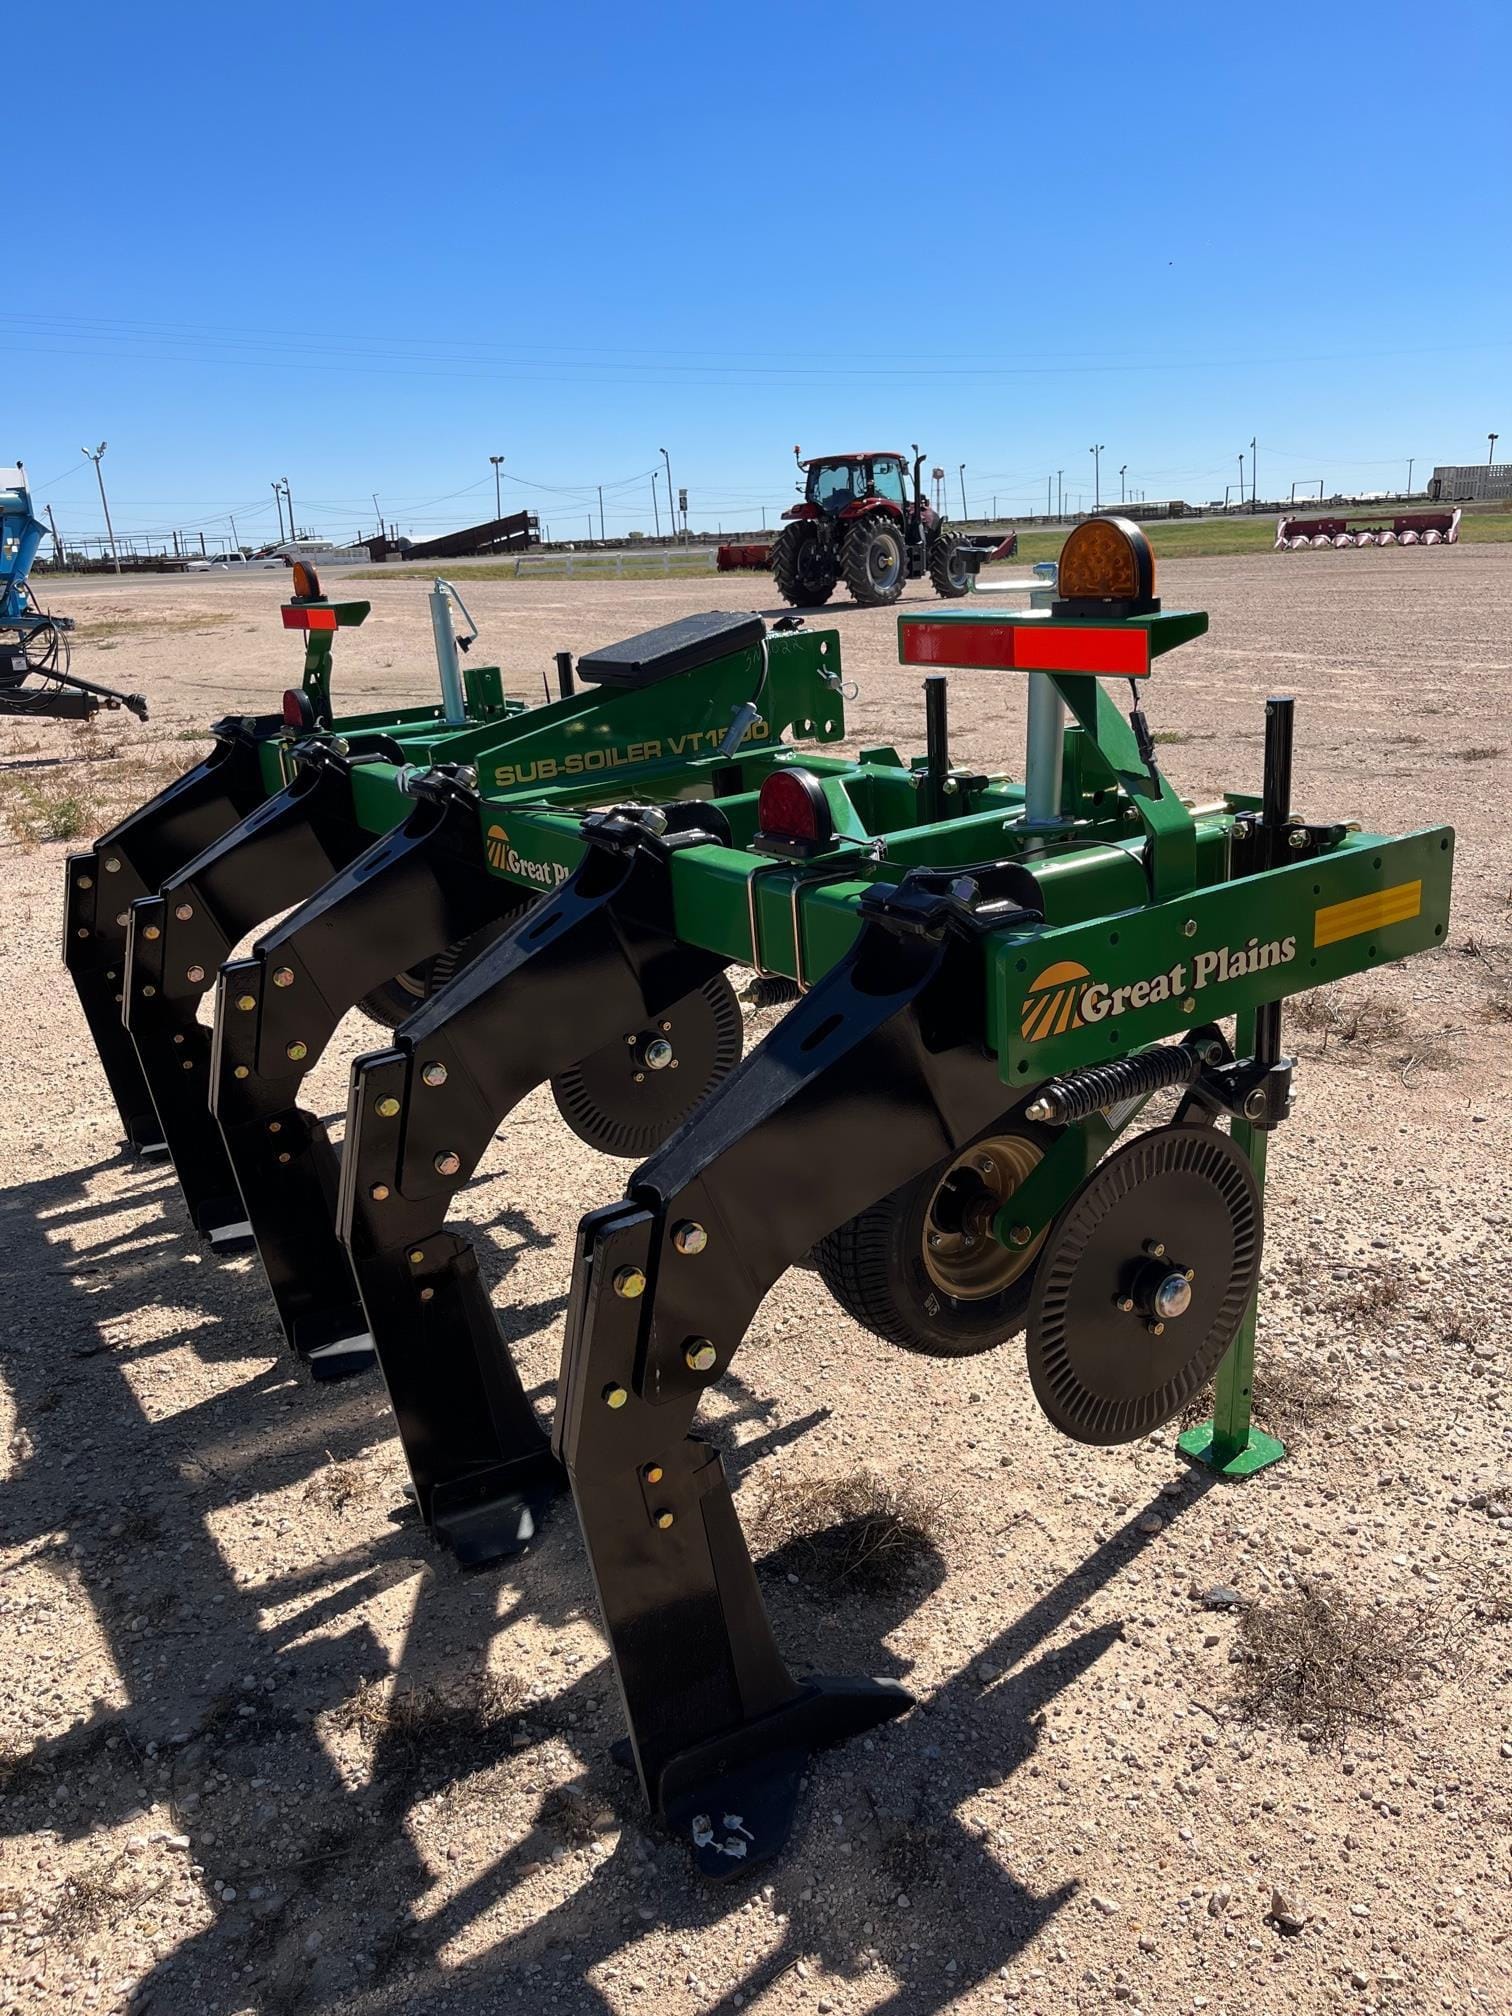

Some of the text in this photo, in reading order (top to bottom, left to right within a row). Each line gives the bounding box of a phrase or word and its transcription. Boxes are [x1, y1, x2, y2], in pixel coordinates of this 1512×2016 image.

[495, 739, 662, 787] SUB-SOILER
[508, 849, 552, 884] Great
[1081, 936, 1296, 1023] Great Plains
